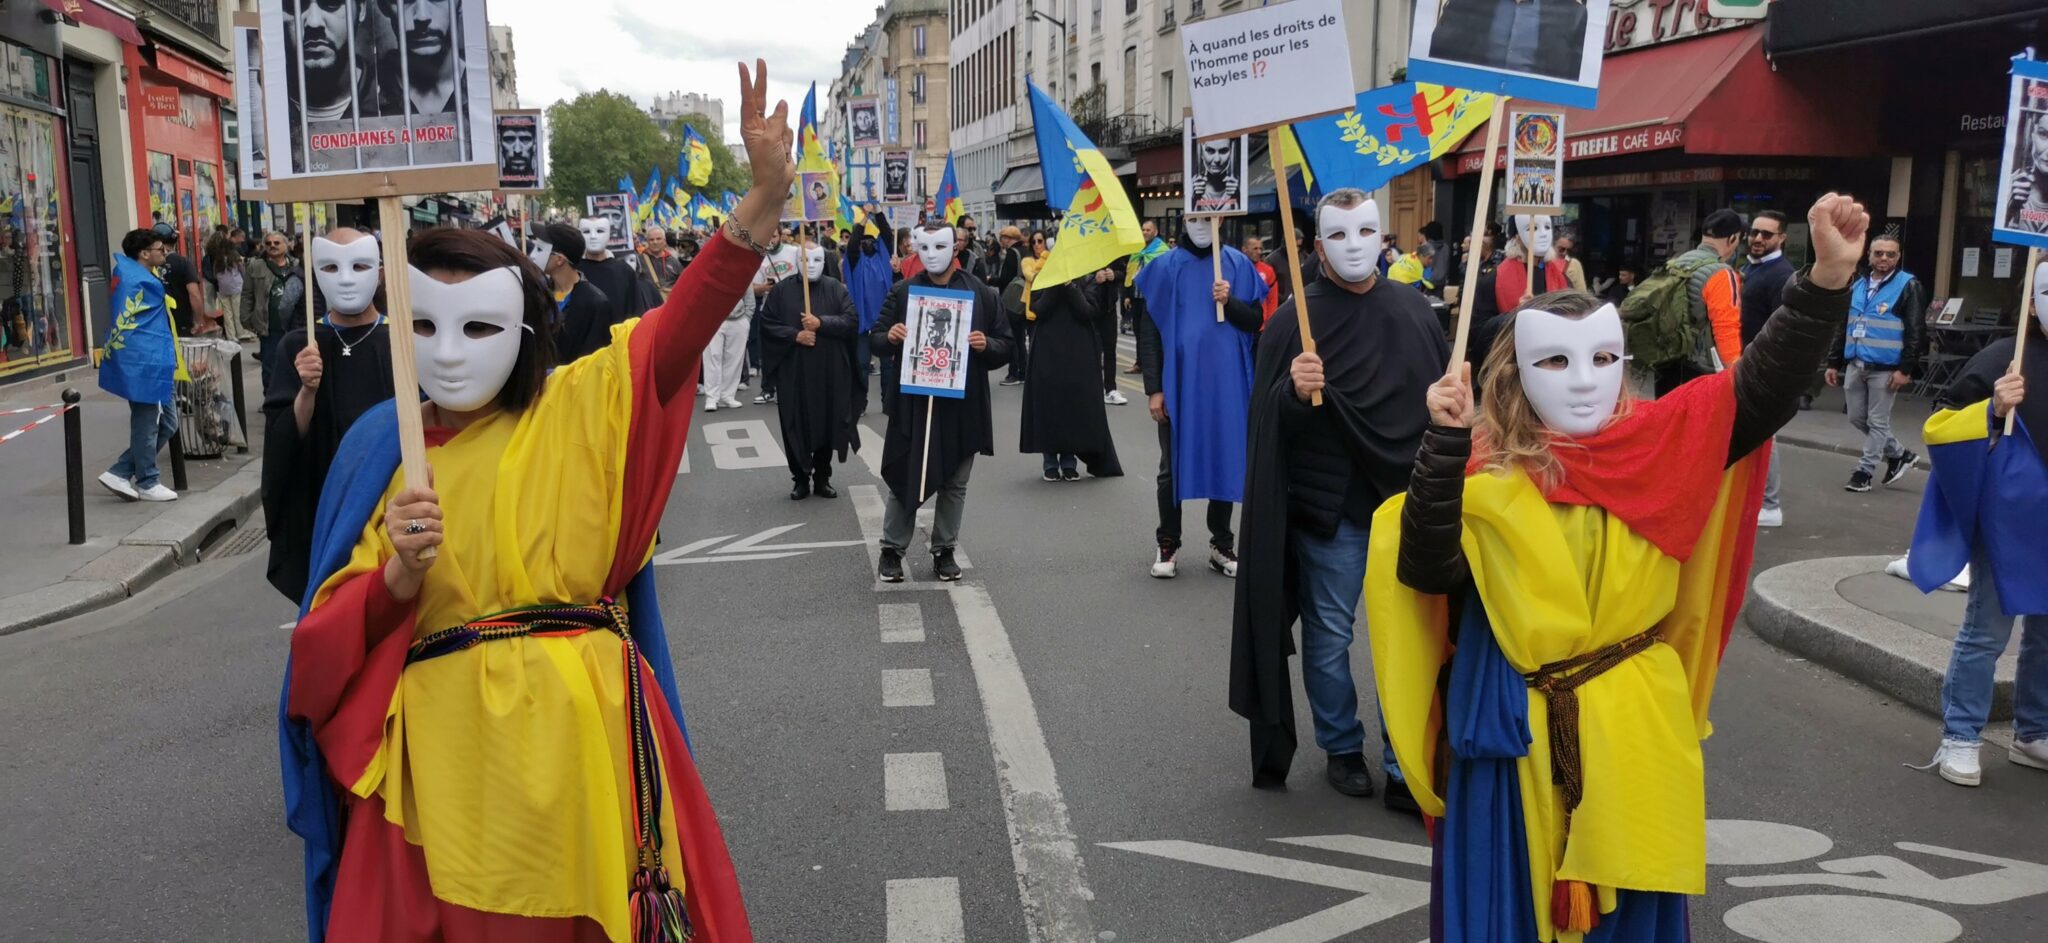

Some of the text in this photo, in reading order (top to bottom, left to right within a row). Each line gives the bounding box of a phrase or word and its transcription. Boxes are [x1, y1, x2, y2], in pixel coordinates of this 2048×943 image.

[1189, 14, 1336, 56] À quand les droits de
[1603, 10, 1637, 50] le
[1190, 39, 1309, 72] l'homme pour les
[1193, 69, 1248, 89] Kabyles
[1961, 115, 2008, 131] Restau
[311, 125, 455, 150] CONDAMNÉS À MORT
[1571, 136, 1618, 157] TREFLE
[1623, 129, 1648, 150] CAFÉ
[1654, 128, 1682, 146] BAR
[1465, 157, 1484, 170] TABA
[921, 346, 950, 369] 38
